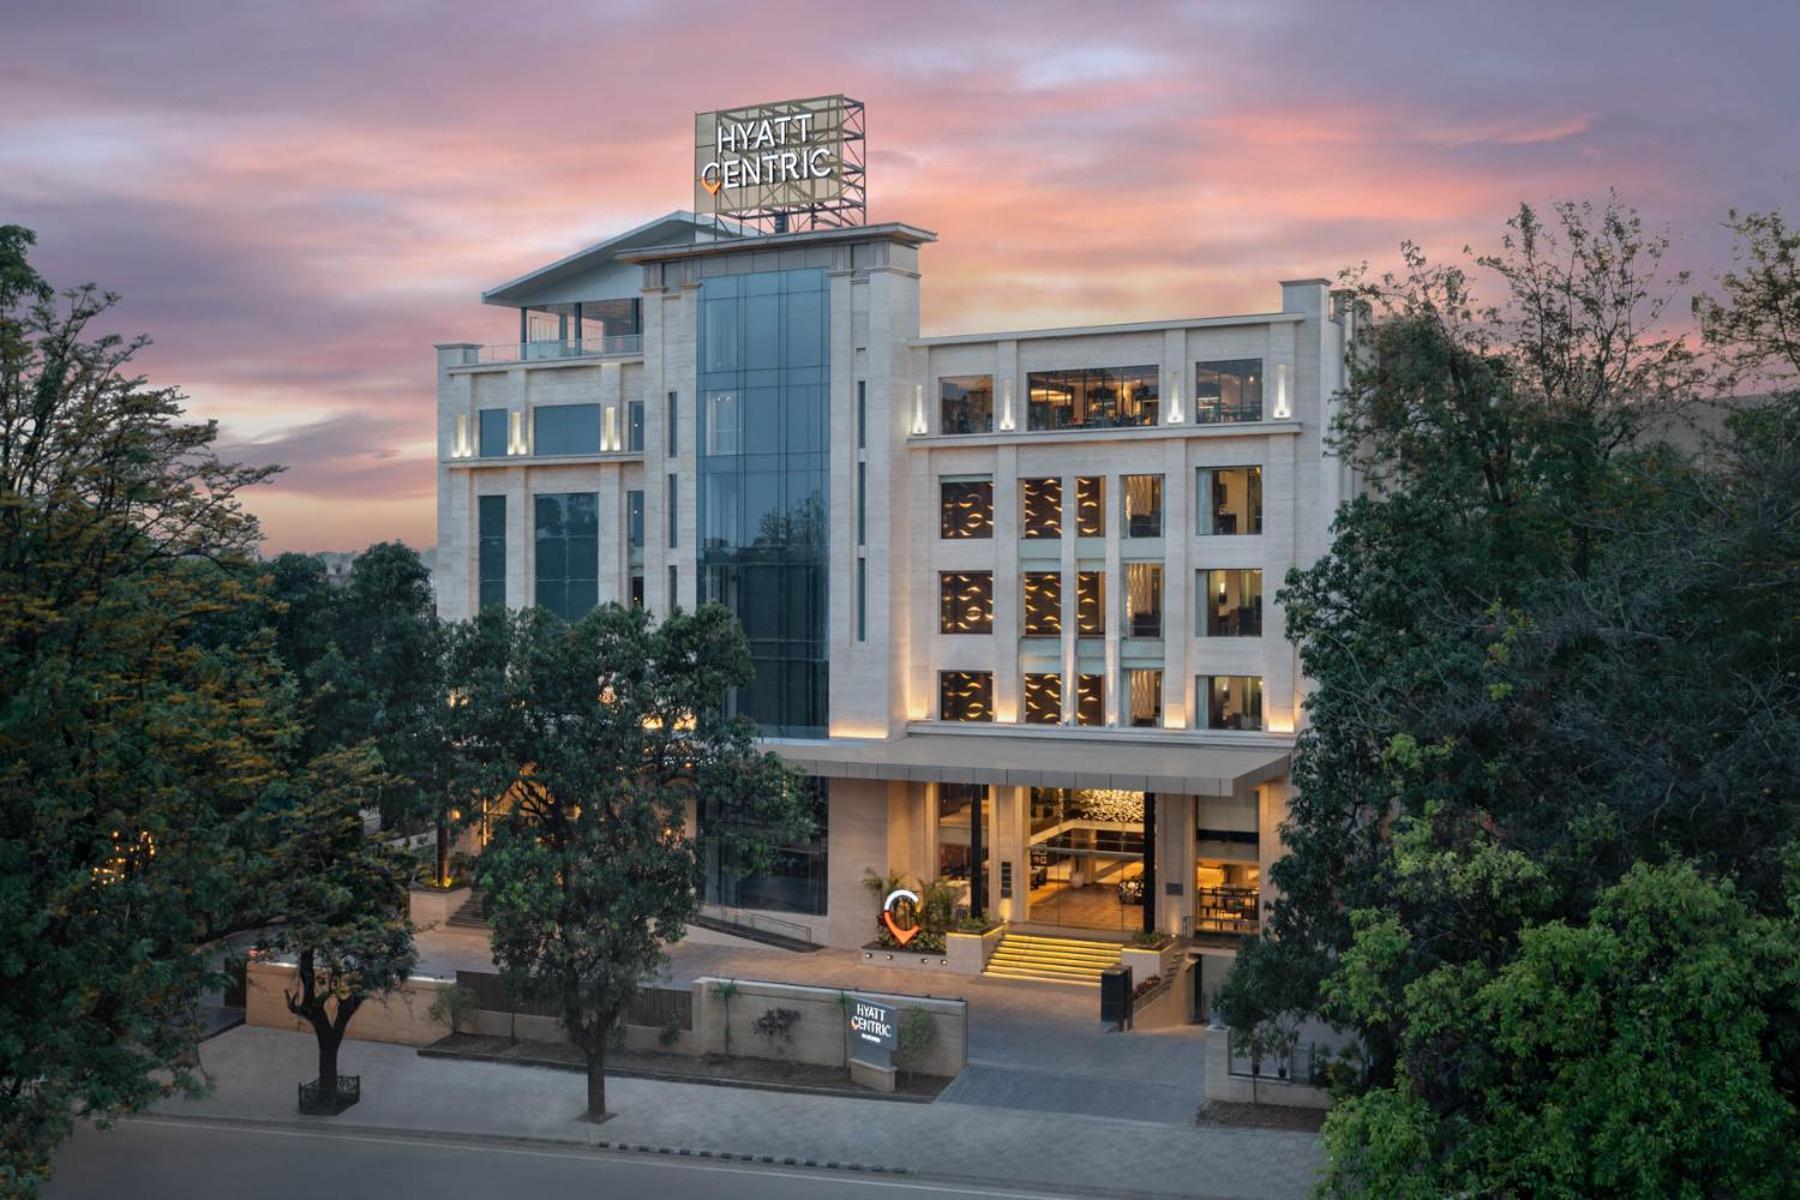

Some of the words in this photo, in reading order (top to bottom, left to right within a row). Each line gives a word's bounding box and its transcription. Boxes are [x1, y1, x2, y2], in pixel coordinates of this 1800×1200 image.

[717, 113, 812, 153] HYATT
[701, 148, 831, 196] CENTRIC
[851, 1015, 892, 1038] CENTRIC
[857, 1003, 886, 1022] HYATT
